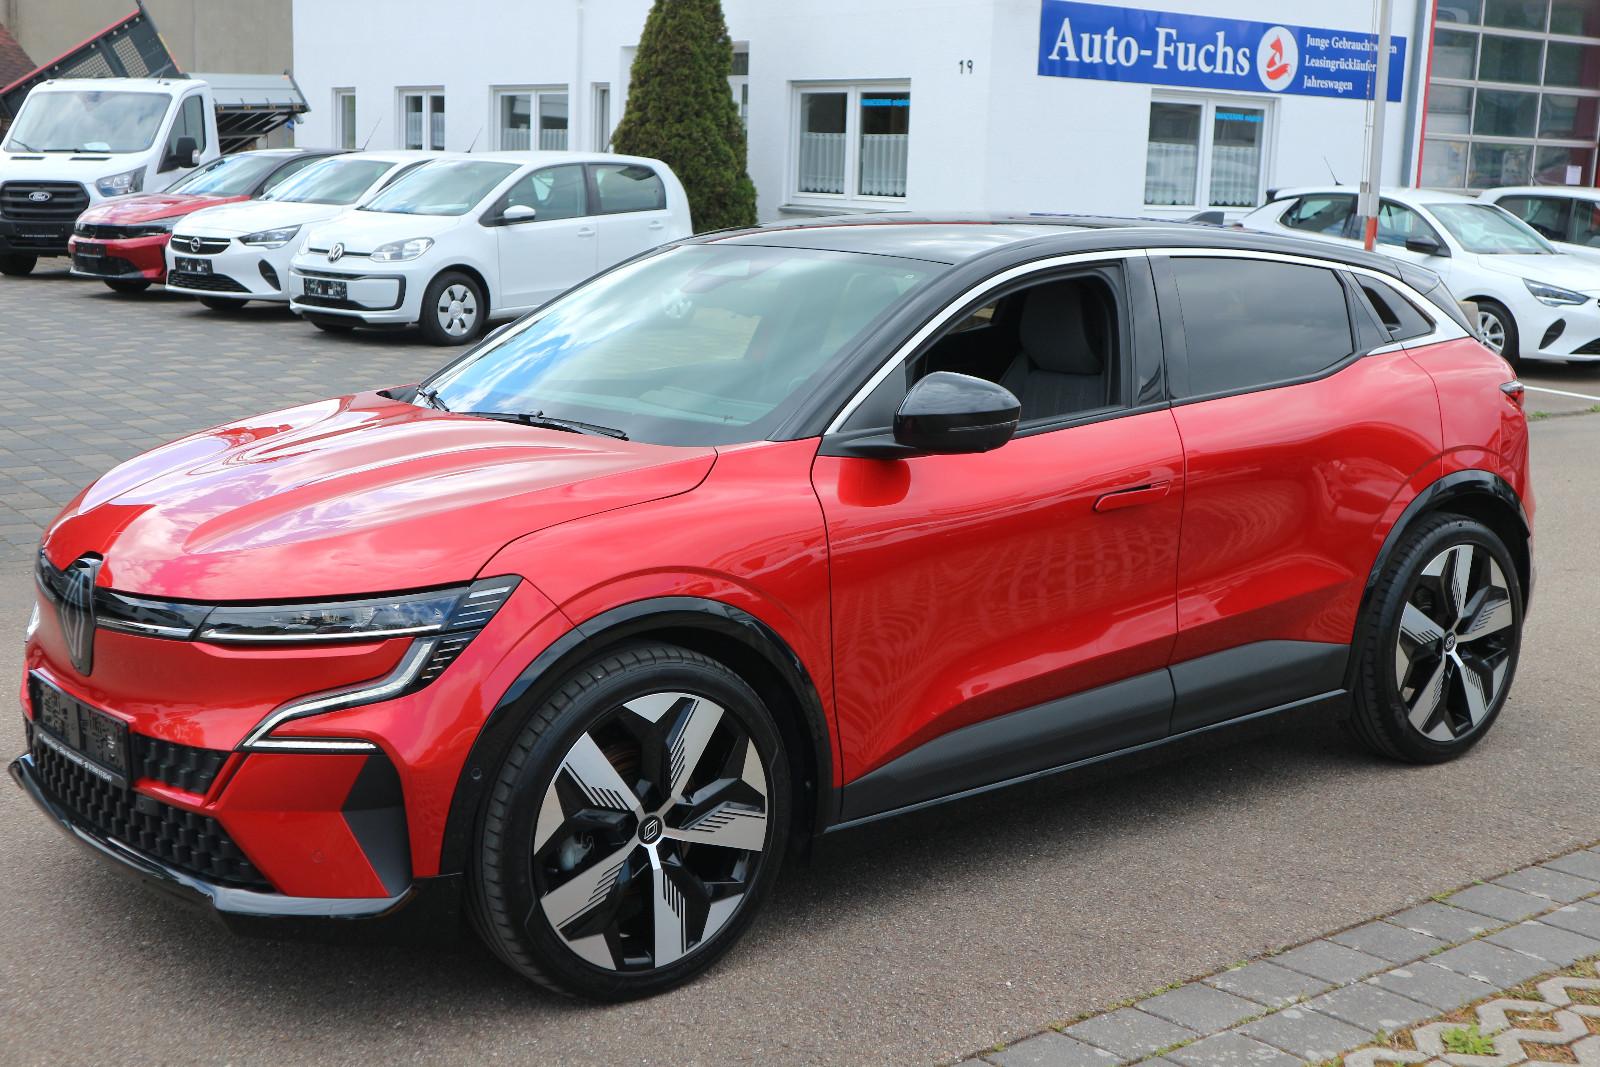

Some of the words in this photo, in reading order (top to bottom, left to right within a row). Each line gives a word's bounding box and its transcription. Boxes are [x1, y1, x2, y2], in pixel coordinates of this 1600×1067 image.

[1048, 17, 1250, 76] Auto-Fuchs
[1306, 34, 1329, 51] Junge
[959, 59, 973, 74] 19
[1305, 54, 1377, 72] Leasingrückläufer
[1303, 75, 1353, 93] Jahreswagen
